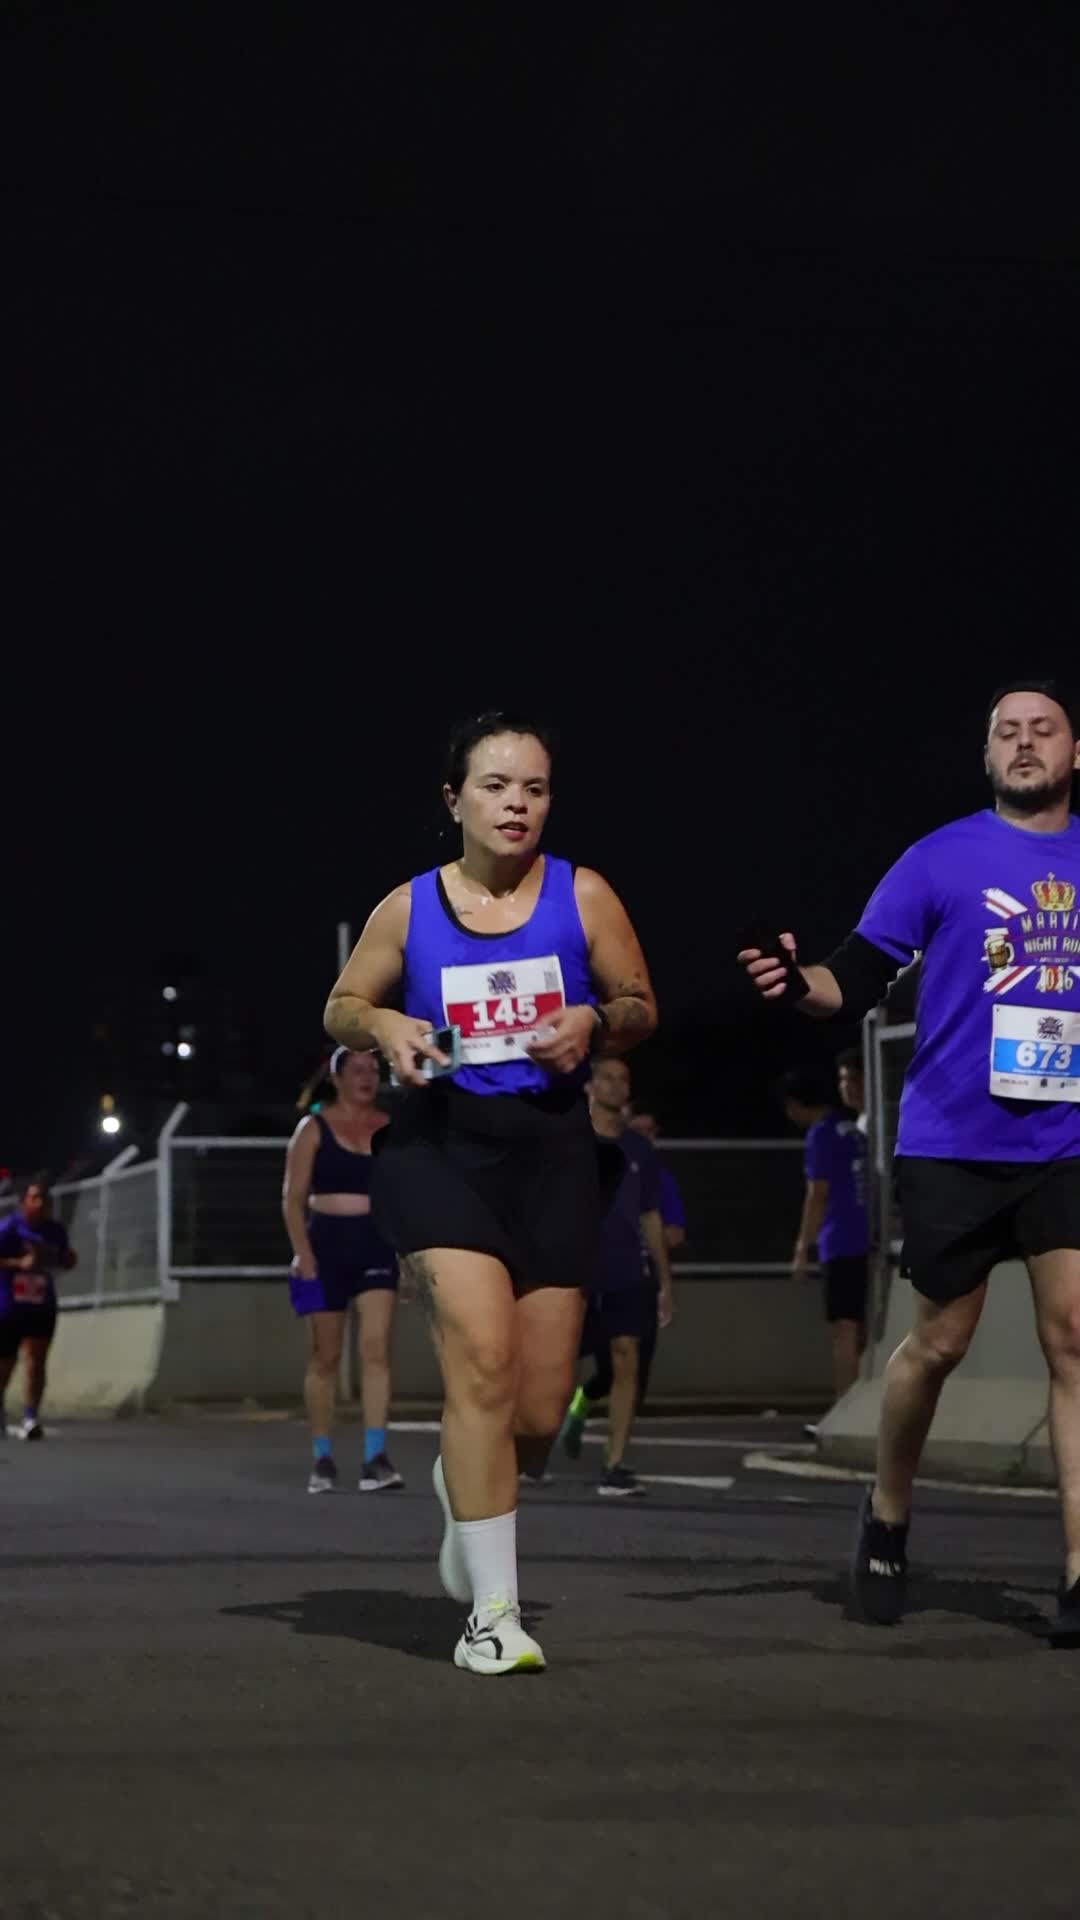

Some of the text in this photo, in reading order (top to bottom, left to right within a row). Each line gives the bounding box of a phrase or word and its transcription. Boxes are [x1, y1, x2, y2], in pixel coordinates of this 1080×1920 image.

[1024, 936, 1080, 953] NIGHT RU
[472, 996, 537, 1029] 145
[1016, 1041, 1072, 1070] 673
